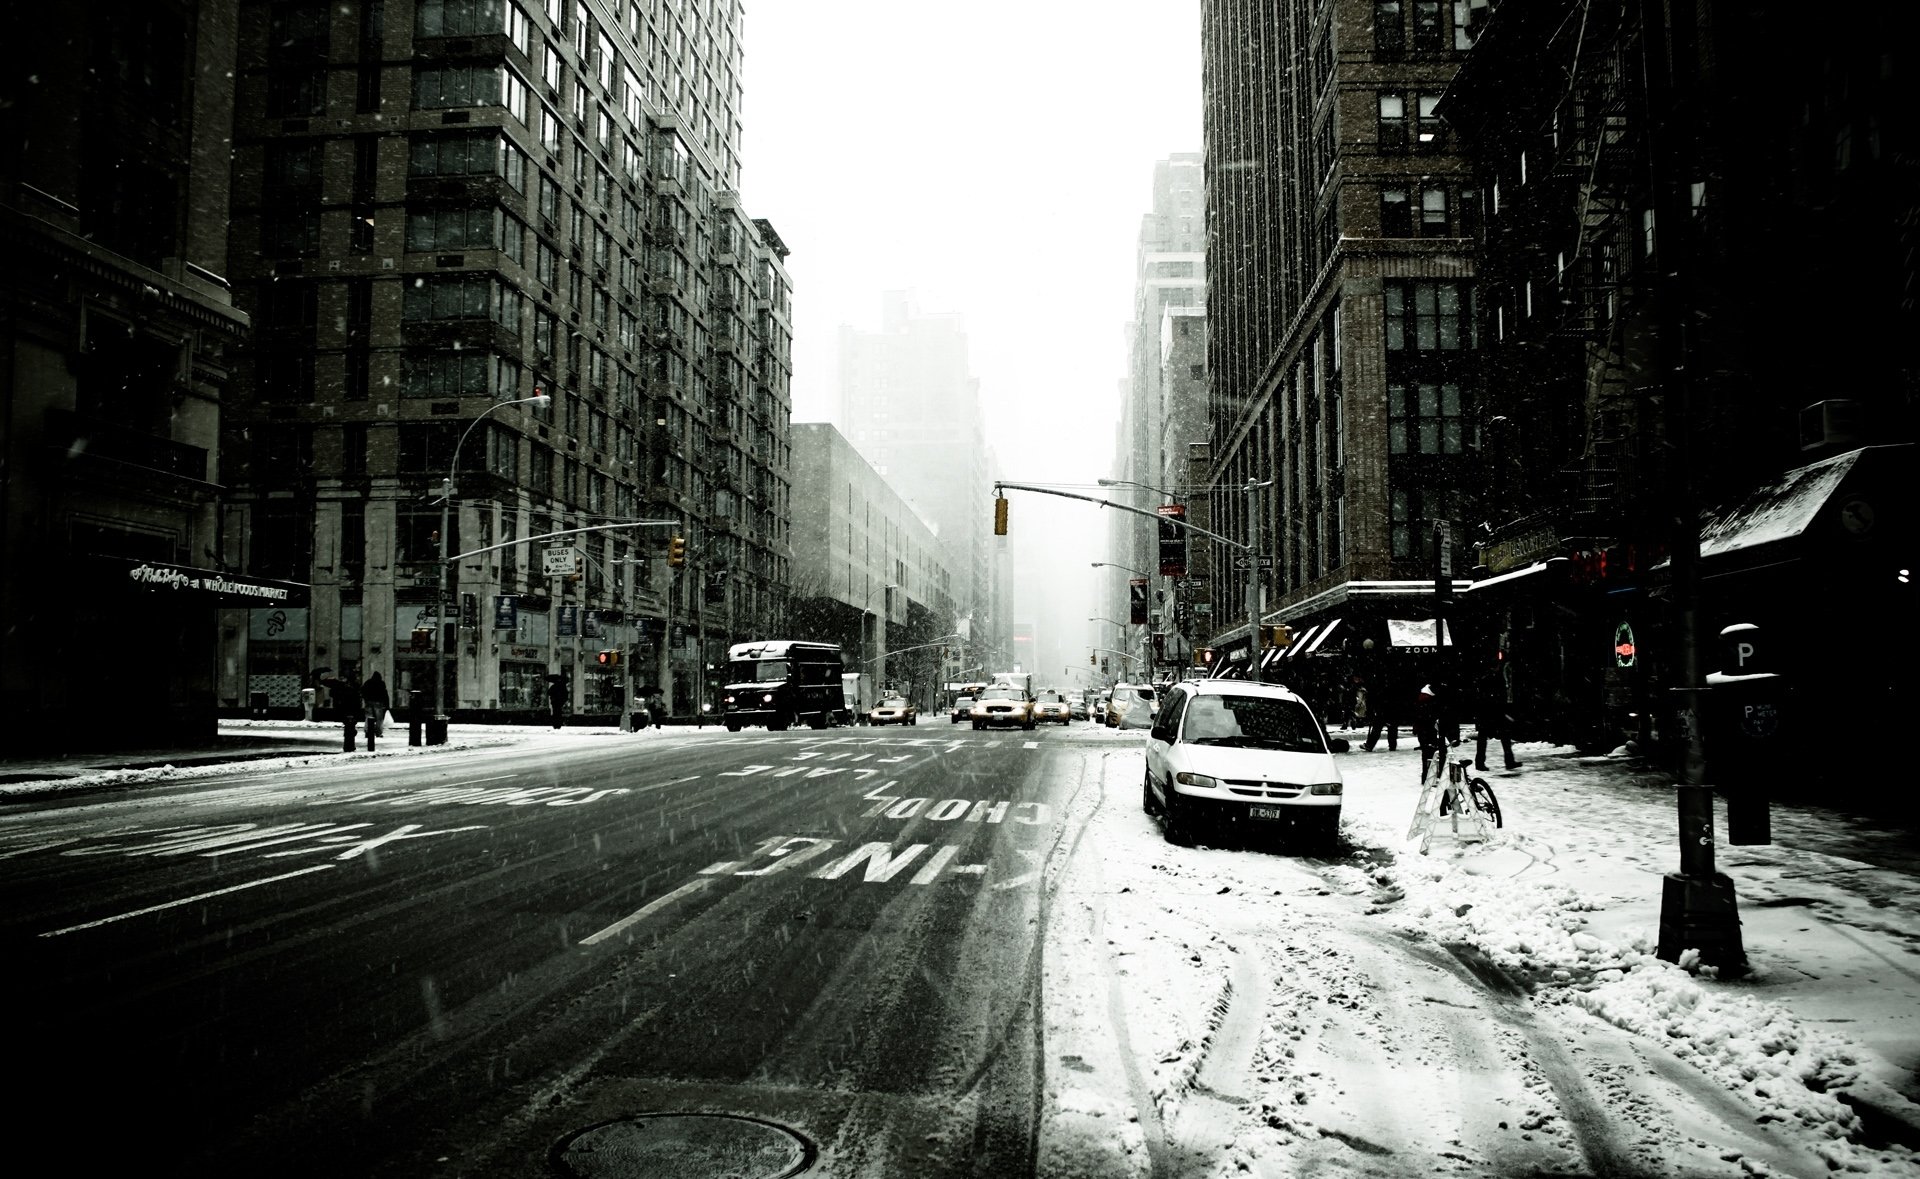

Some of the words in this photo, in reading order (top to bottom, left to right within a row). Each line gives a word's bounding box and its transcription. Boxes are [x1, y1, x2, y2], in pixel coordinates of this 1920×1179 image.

[202, 576, 233, 593] WHOLE
[233, 583, 259, 597] FOODS
[259, 586, 289, 600] MARKET
[1738, 643, 1754, 667] P
[1744, 705, 1754, 718] P
[860, 796, 1051, 825] CHOOL
